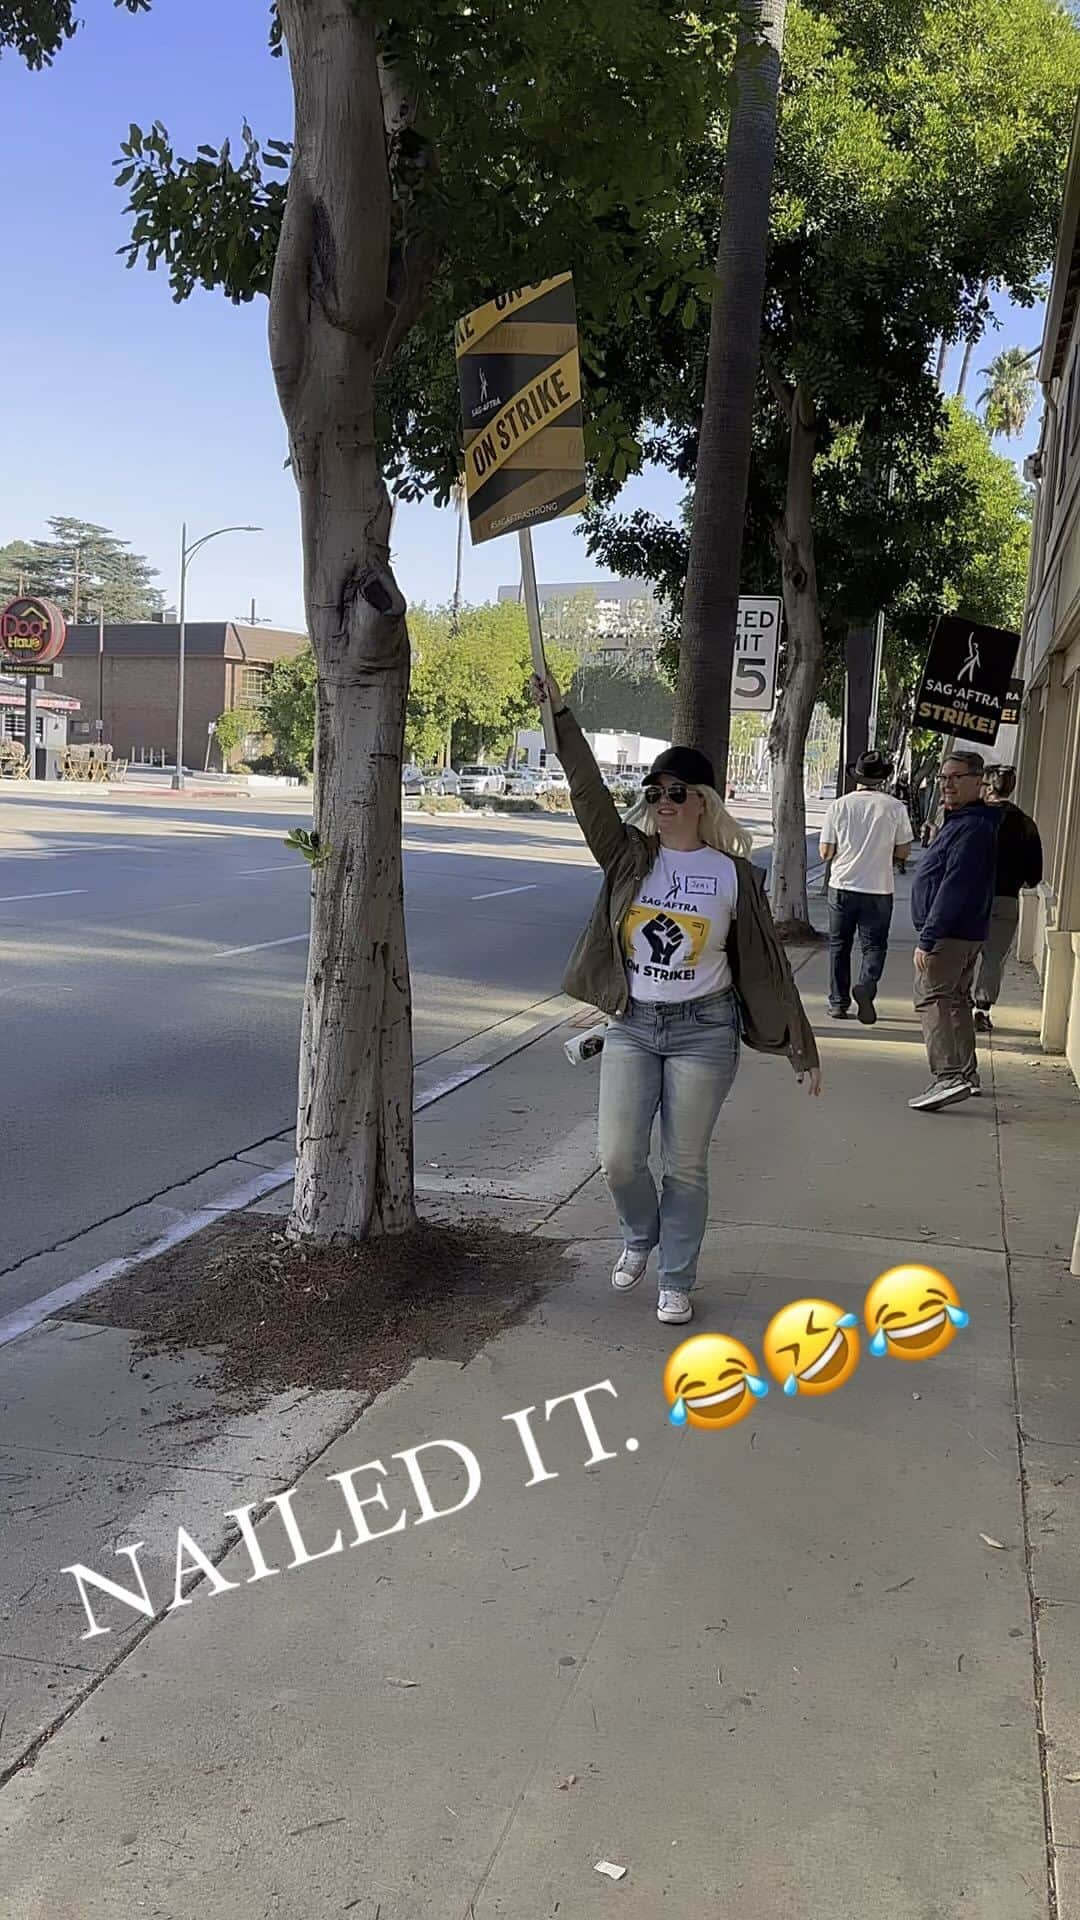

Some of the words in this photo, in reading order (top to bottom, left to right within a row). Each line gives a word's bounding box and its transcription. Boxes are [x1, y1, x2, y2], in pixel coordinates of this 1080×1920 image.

[473, 432, 497, 477] ON
[496, 368, 571, 450] STRIKE
[952, 700, 968, 711] ON
[919, 702, 996, 734] STRIKE!
[643, 965, 695, 981] STRIKE!
